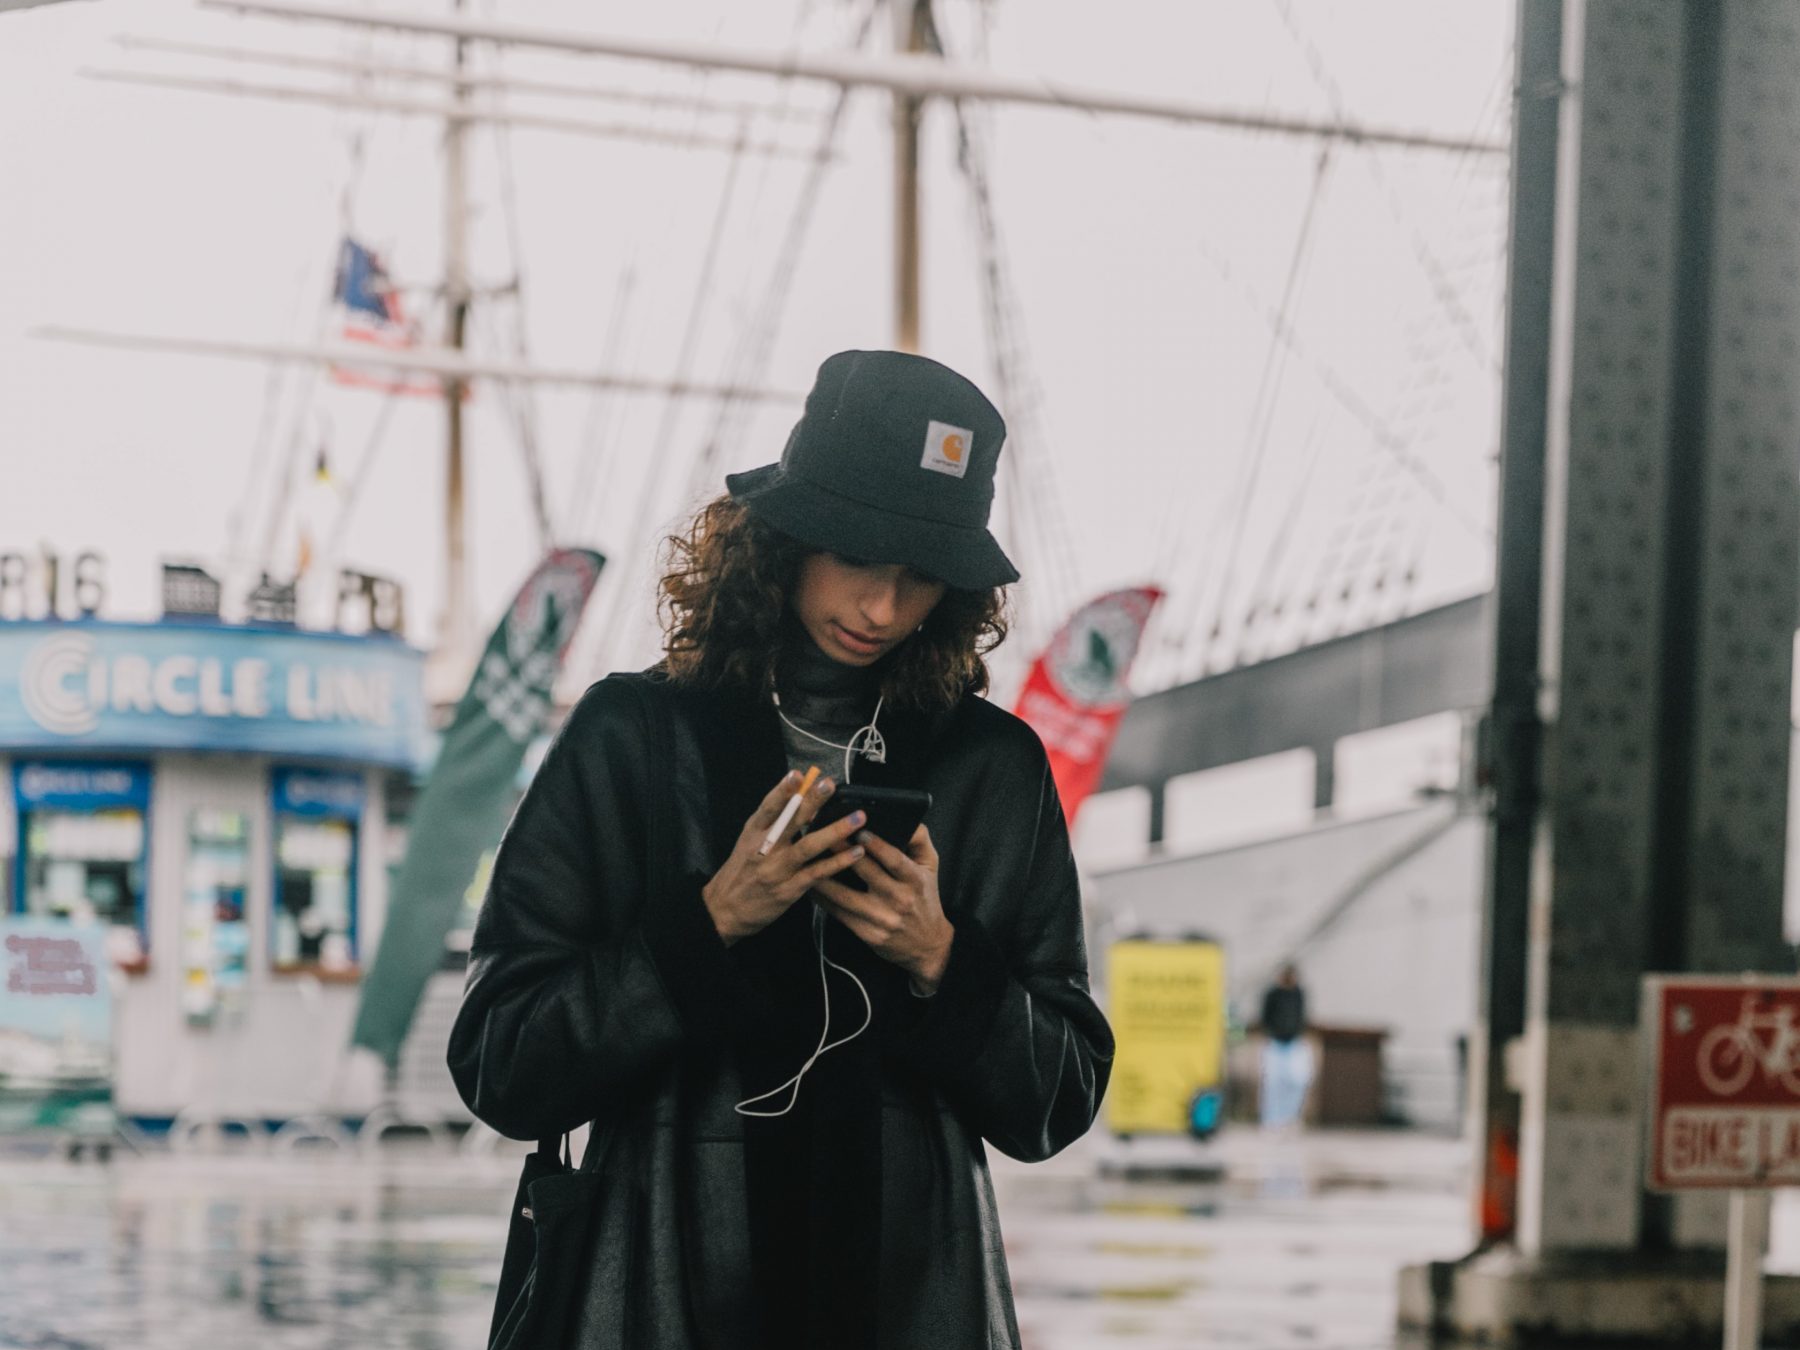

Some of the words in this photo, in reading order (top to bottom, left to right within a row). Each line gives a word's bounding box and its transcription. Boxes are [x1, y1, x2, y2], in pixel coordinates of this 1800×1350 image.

[24, 631, 270, 734] CIRCLE
[289, 664, 397, 728] LINE
[1672, 1115, 1745, 1168] BIKE
